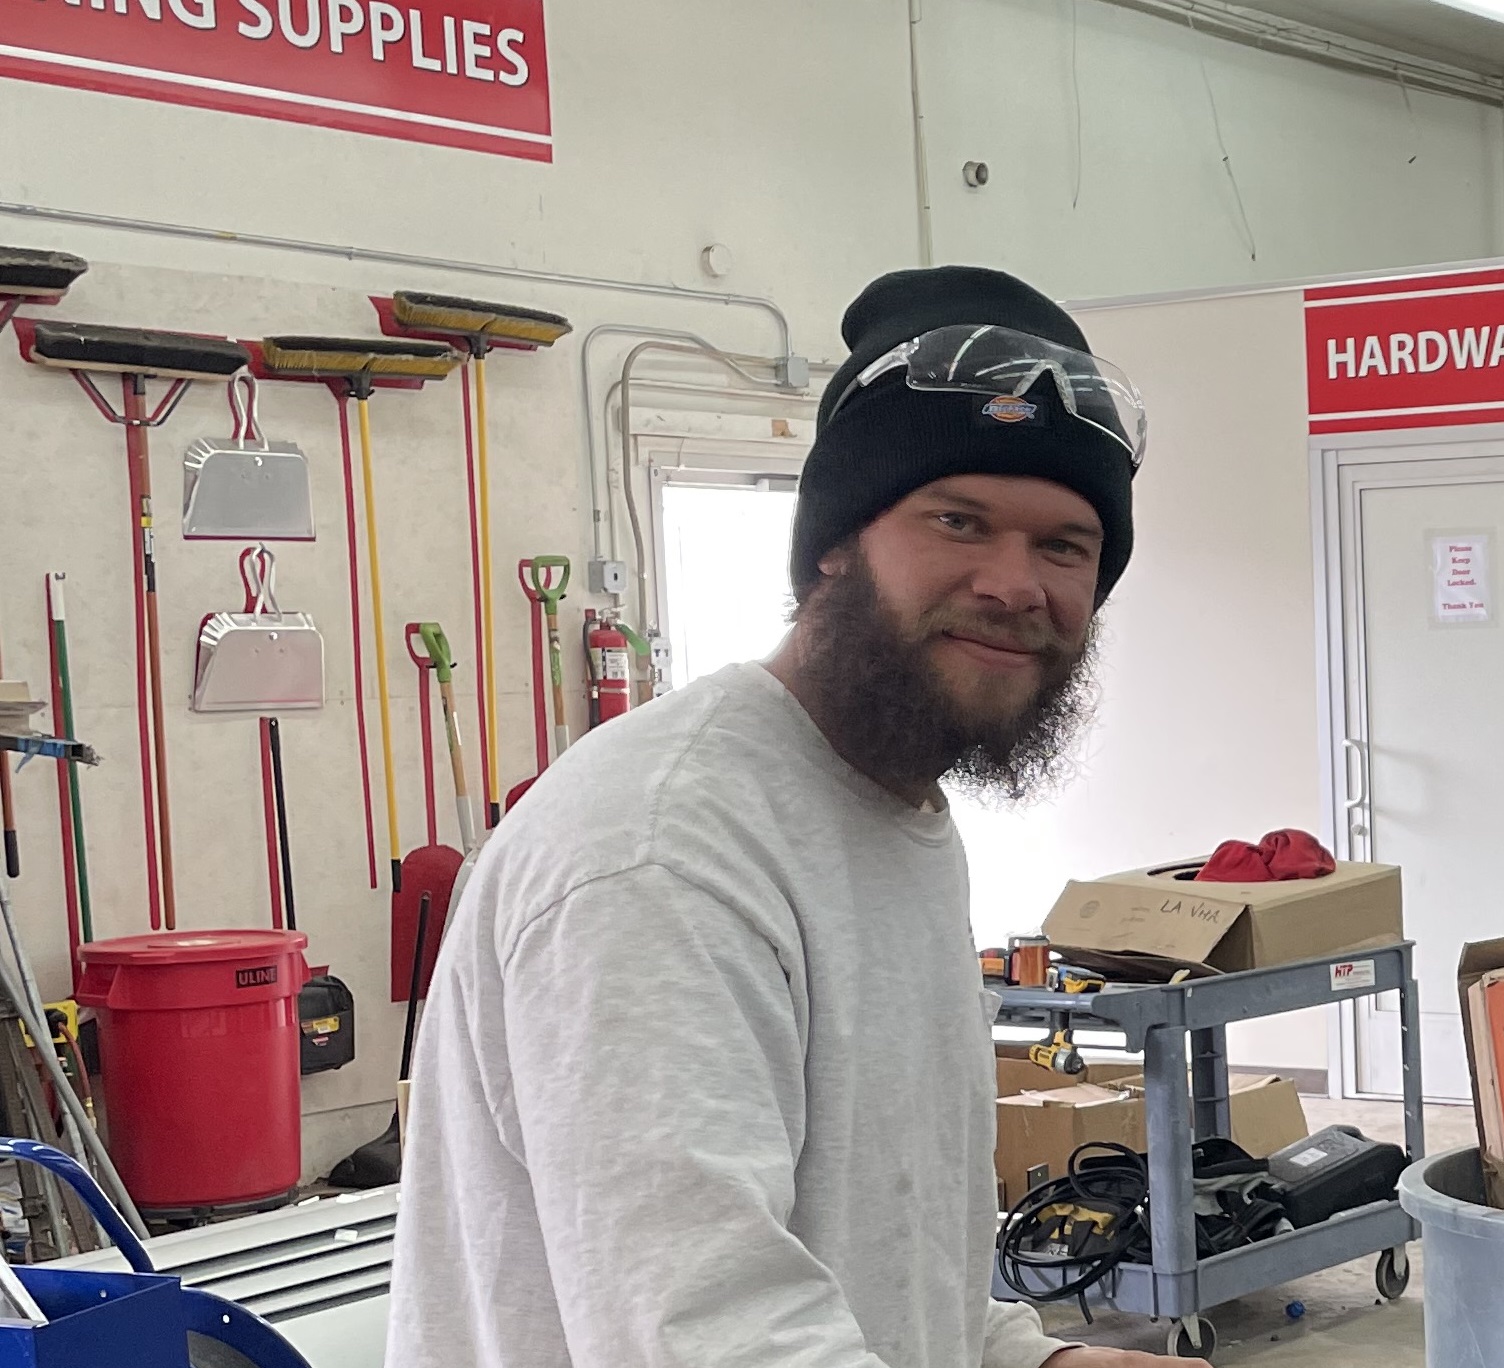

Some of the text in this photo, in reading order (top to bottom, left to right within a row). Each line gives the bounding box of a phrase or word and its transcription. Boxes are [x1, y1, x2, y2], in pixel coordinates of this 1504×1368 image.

[237, 0, 530, 87] SUPPLIES
[1449, 545, 1472, 553] Please
[1442, 602, 1467, 610] Thank
[1160, 900, 1182, 914] LA
